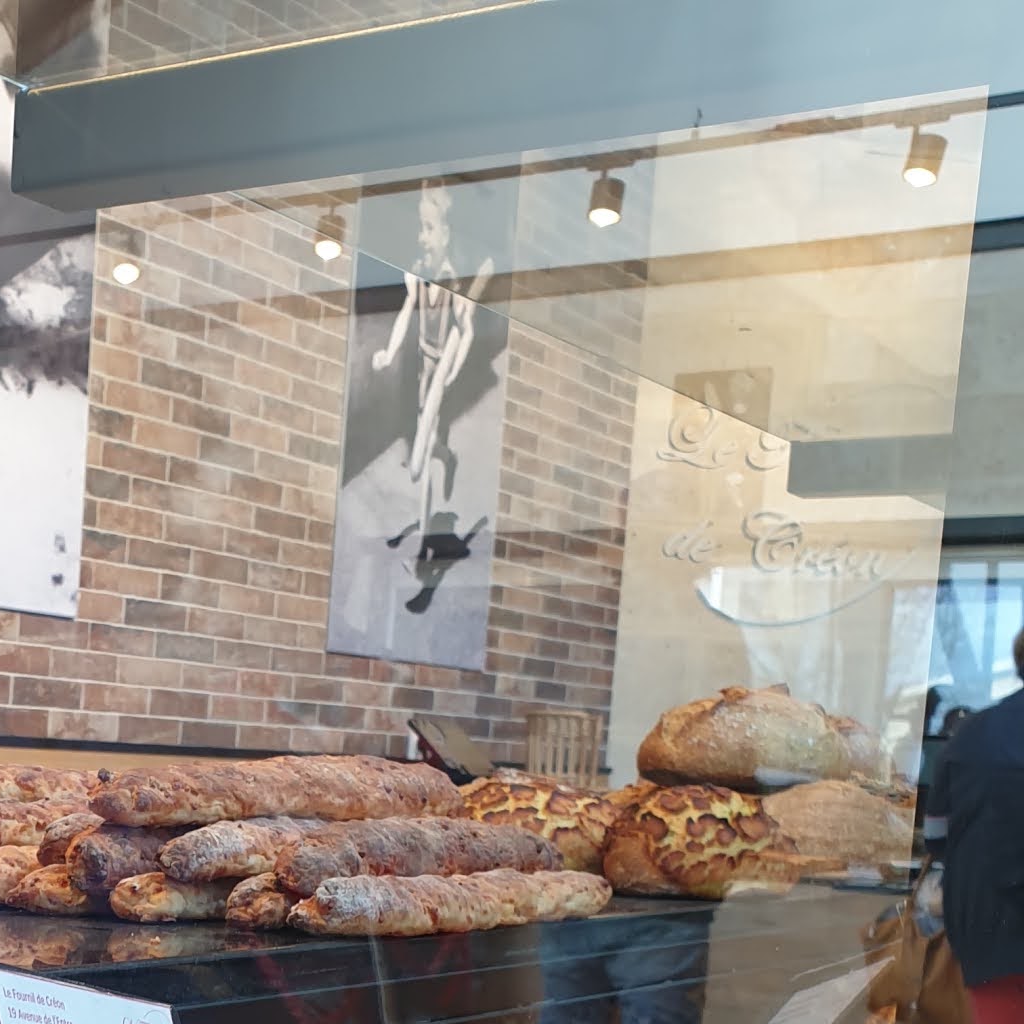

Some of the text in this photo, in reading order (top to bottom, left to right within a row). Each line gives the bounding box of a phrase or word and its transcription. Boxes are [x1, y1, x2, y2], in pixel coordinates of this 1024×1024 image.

[2, 986, 12, 999] Le
[12, 988, 36, 1003] Fournil
[36, 993, 46, 1006] de
[7, 1006, 17, 1019] 19
[18, 1008, 42, 1024] Avenue
